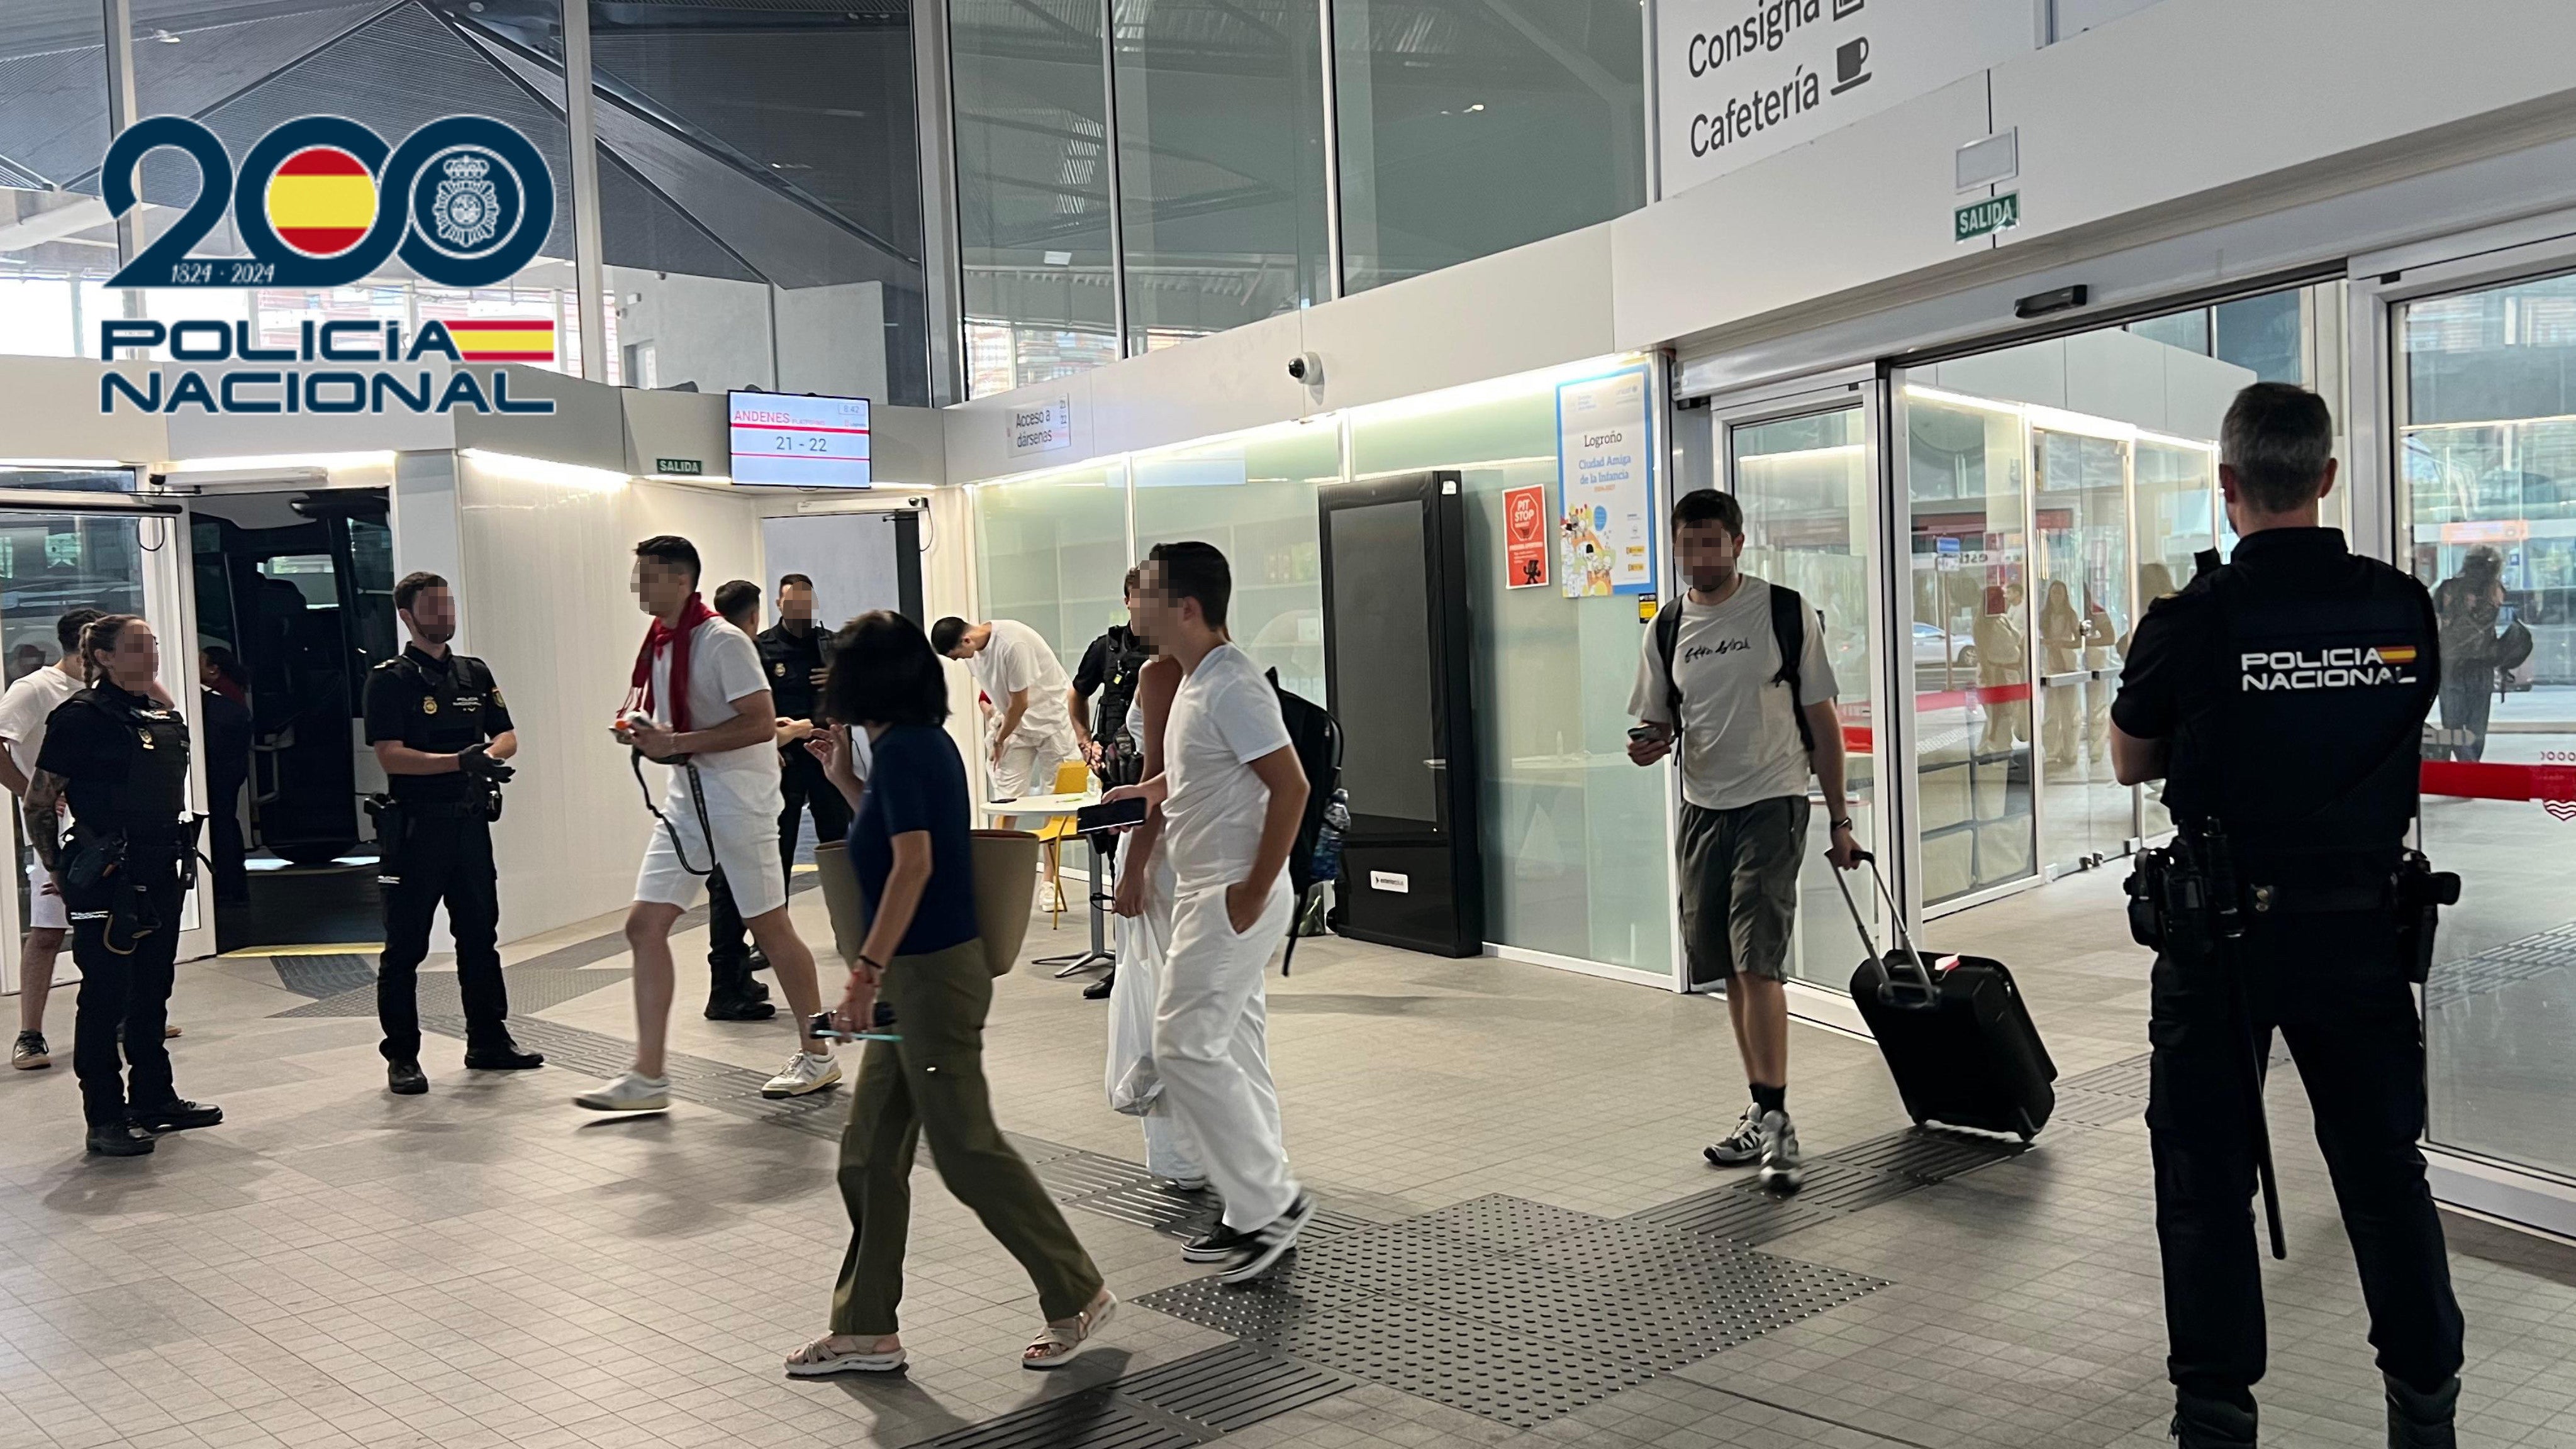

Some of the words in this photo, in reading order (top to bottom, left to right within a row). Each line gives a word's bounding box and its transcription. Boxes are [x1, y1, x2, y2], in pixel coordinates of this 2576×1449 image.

[1688, 0, 1820, 78] Consigna
[1690, 64, 1820, 158] Cafetería
[1960, 199, 2013, 233] SALIDA
[734, 410, 790, 424] ANDENES
[1017, 412, 1044, 428] Acceso
[1045, 409, 1050, 421] a
[776, 436, 792, 450] 21
[810, 438, 827, 452] 22
[1017, 430, 1052, 448] dársenas
[1584, 430, 1622, 448] Logroño
[660, 460, 700, 472] SALIDA
[1579, 457, 1605, 470] Ciudad
[1607, 455, 1631, 466] Amiga
[1580, 475, 1588, 484] de
[1591, 473, 1597, 483] la
[1598, 470, 1629, 482] Infancia
[1517, 499, 1530, 511] PIT
[1515, 509, 1534, 522] STOP
[2242, 666, 2417, 692] NACIONAL
